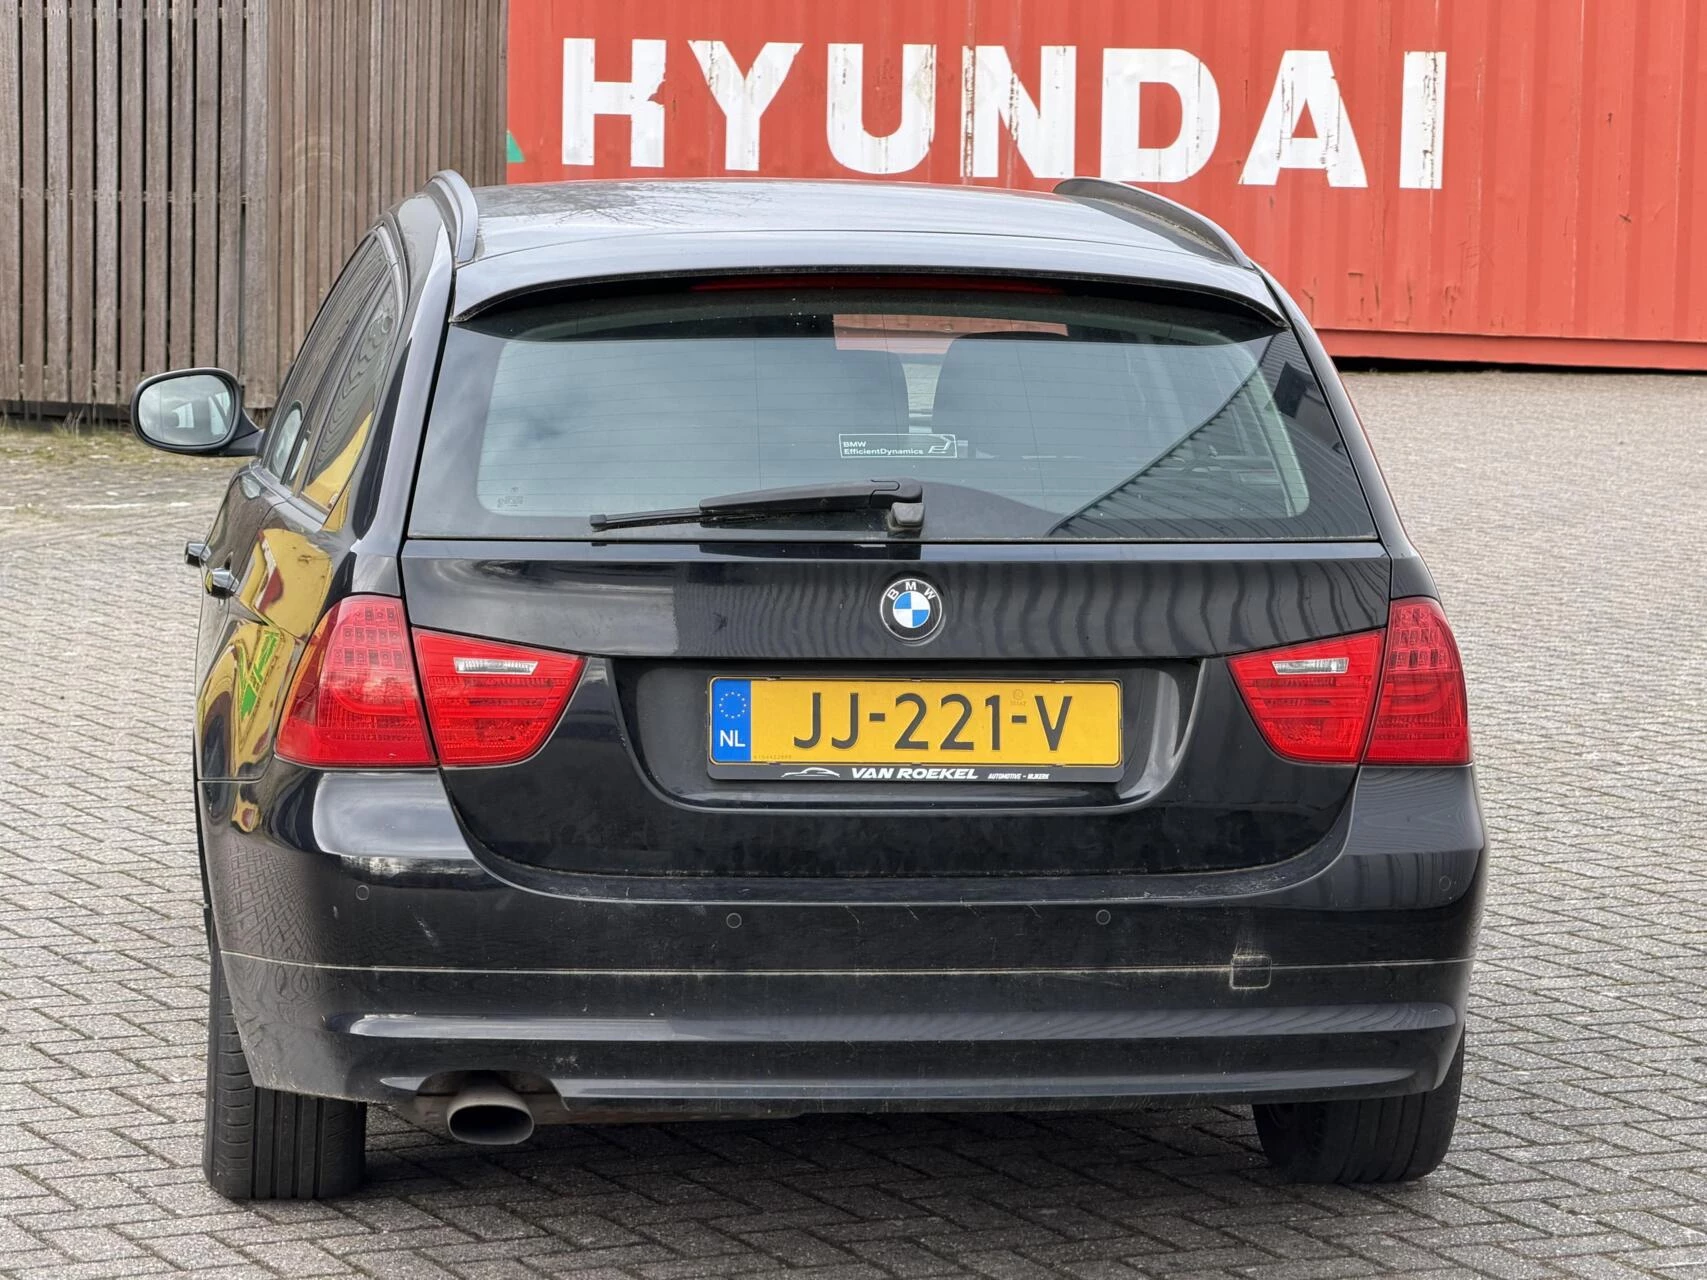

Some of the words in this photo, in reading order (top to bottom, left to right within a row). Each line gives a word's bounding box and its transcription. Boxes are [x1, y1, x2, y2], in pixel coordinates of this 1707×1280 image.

[562, 37, 1447, 190] HYUNDAI
[843, 448, 924, 456] EfficientDynamics
[886, 581, 937, 601] BMW
[793, 692, 1073, 751] JJ-221-V
[719, 730, 746, 748] NL
[851, 767, 894, 779] VAN
[896, 768, 979, 780] ROEKEL
